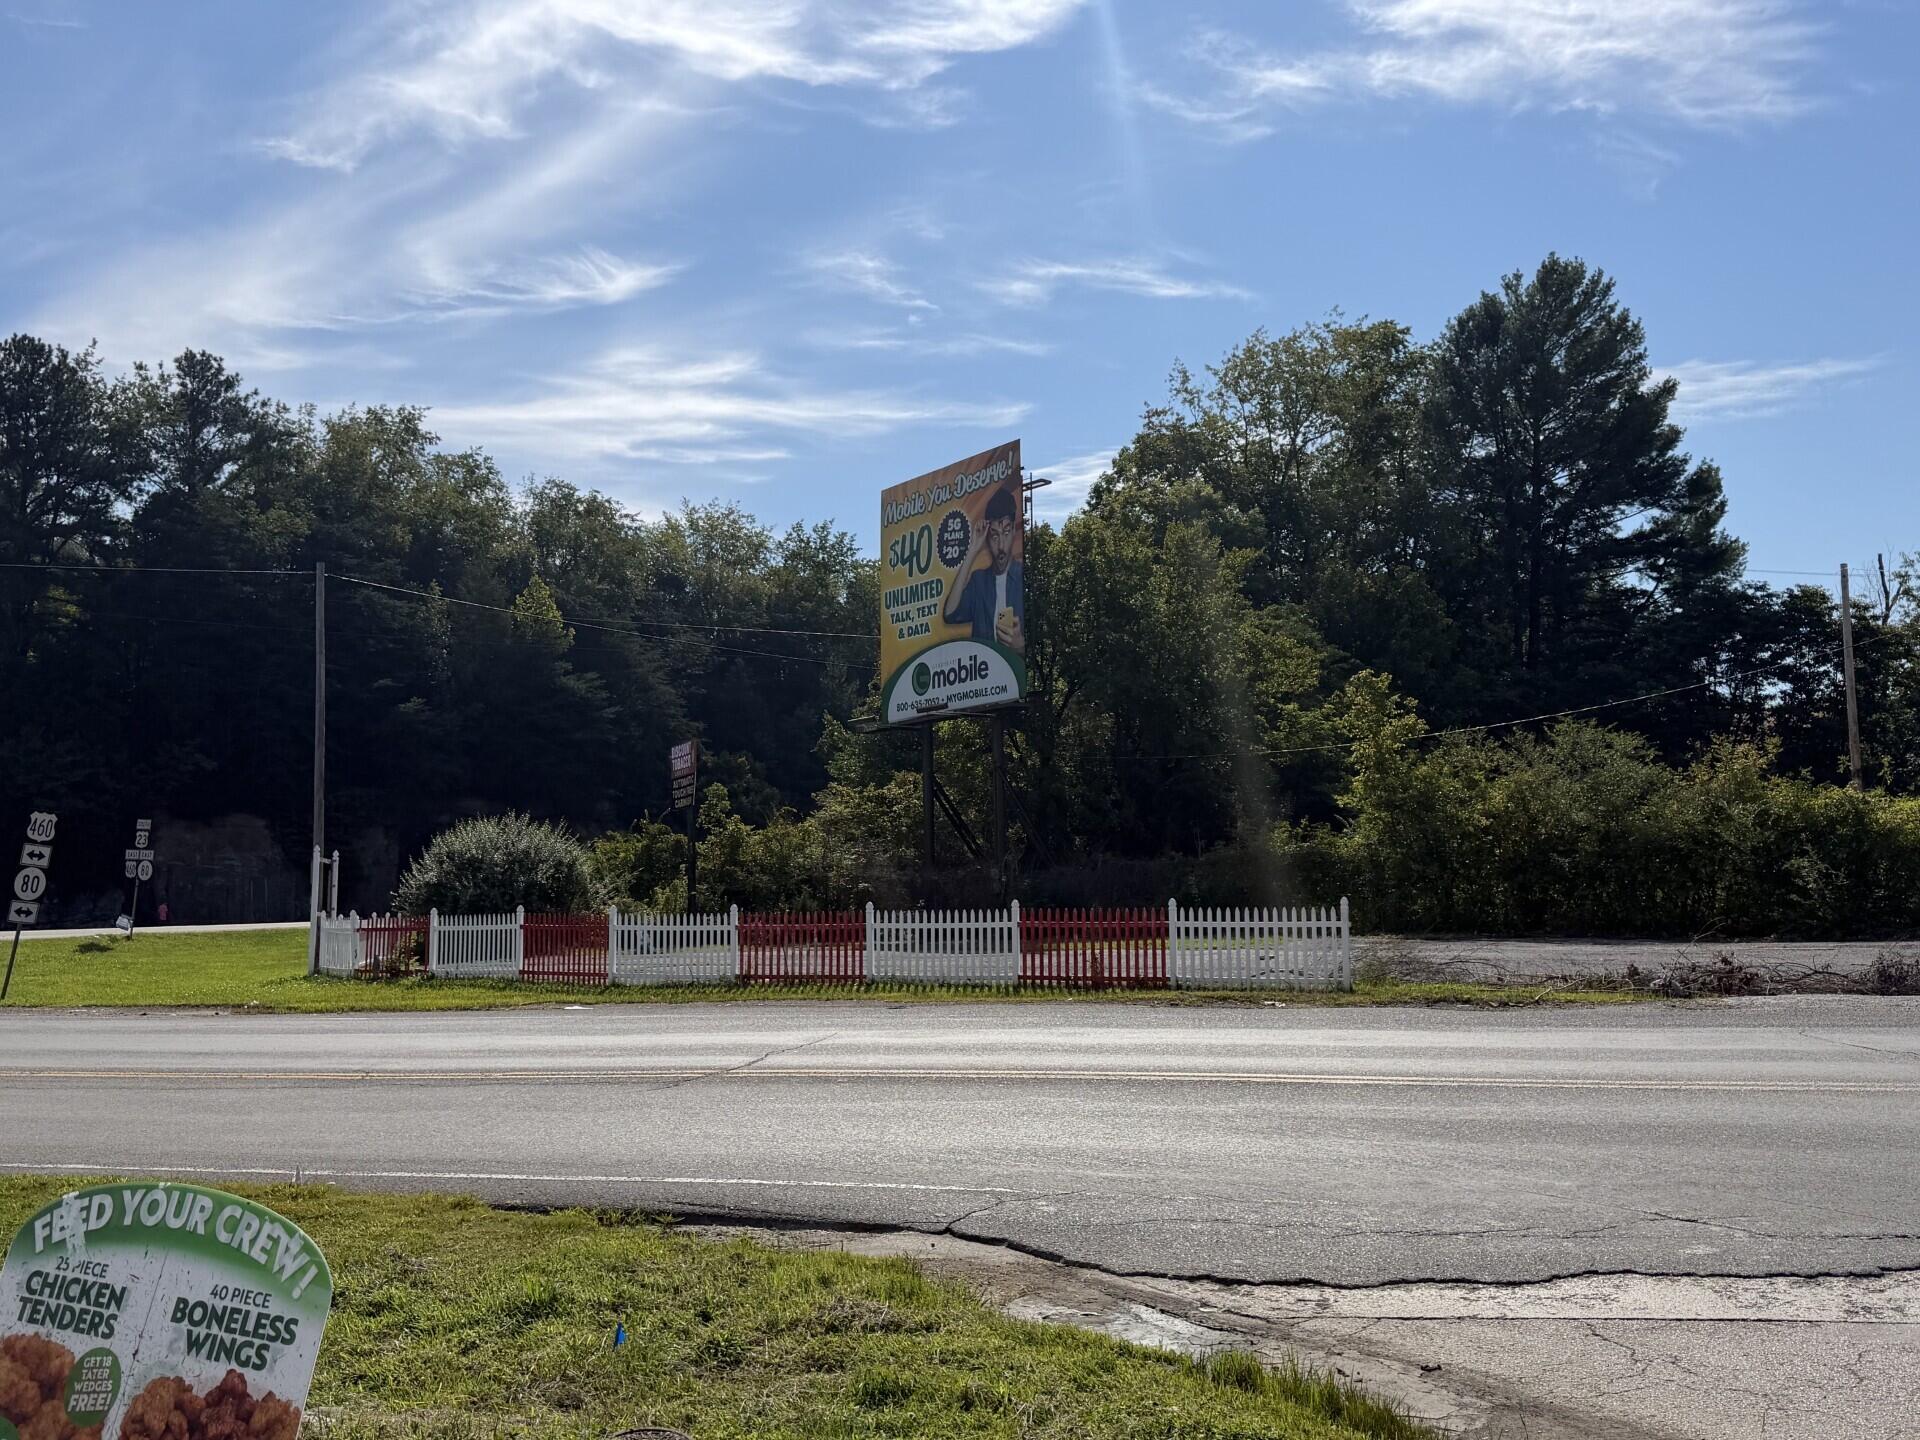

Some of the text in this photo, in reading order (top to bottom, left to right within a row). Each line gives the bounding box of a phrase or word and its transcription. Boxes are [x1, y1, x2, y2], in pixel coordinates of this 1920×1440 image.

[884, 451, 1013, 527] Mobile You Deserve!
[947, 518, 961, 531] 5G
[944, 531, 964, 540] PLANS
[889, 524, 932, 577] $40
[943, 546, 959, 559] $20
[885, 579, 943, 609] UNLIMITED
[890, 603, 938, 624] TALK, TEXT
[898, 622, 931, 639] & DATA
[946, 684, 1008, 703] MYGMOBILE.COM
[29, 818, 54, 838] 460
[137, 834, 147, 845] 23
[21, 874, 40, 893] 80
[122, 1189, 214, 1235] YOUR
[215, 1205, 318, 1299] CREW!
[55, 1256, 109, 1279] 25 PIECE
[25, 1270, 127, 1313] CHICKEN
[210, 1284, 272, 1309] 40 PIECE
[16, 1296, 118, 1340] TENDERS
[170, 1296, 299, 1346] BONELESS
[185, 1330, 271, 1371] WINGS
[84, 1356, 112, 1368] GET 18
[82, 1368, 110, 1380] TATER
[74, 1380, 113, 1392] WEDGES
[67, 1393, 112, 1412] FREE!
